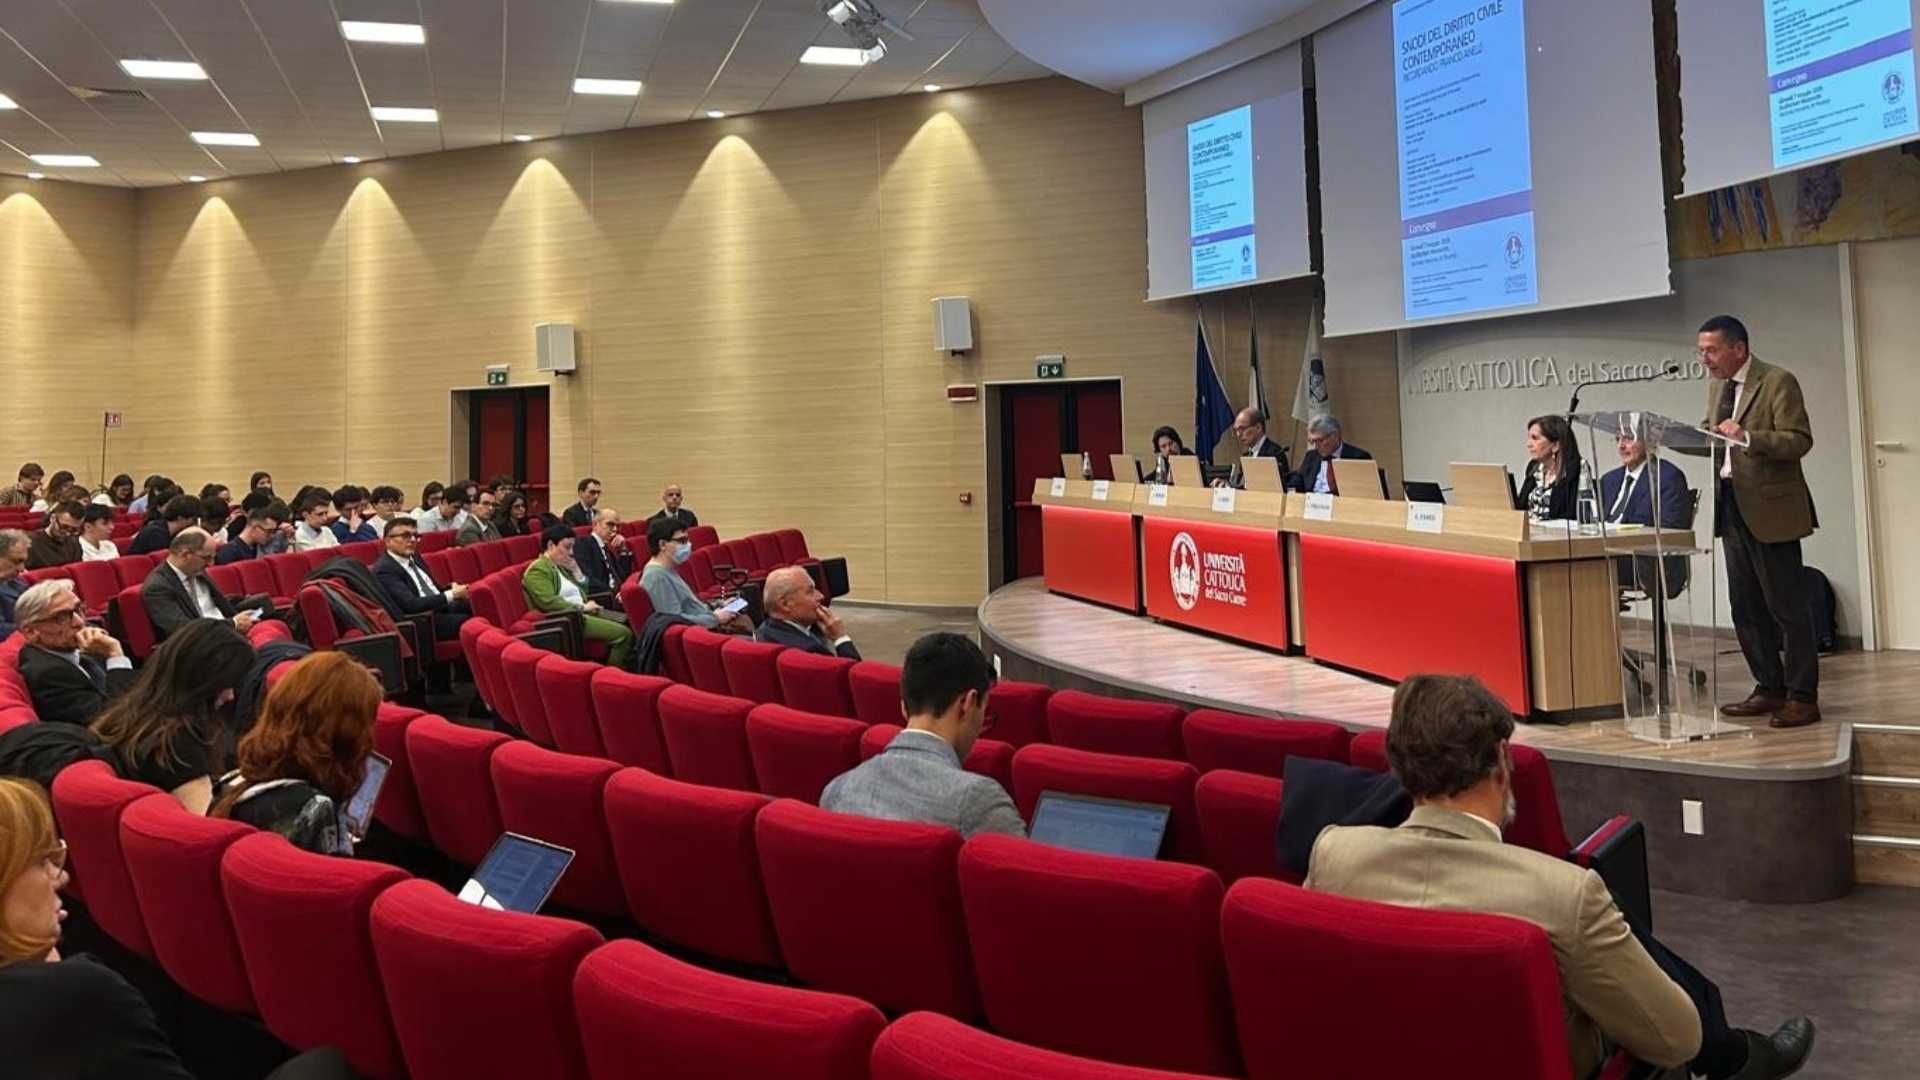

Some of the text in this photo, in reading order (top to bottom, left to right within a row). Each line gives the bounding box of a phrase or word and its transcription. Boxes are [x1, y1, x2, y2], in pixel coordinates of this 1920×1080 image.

[1427, 26, 1442, 43] DEL
[1477, 0, 1503, 21] CIVILE
[1402, 29, 1475, 71] CONTEMPORANEO
[1458, 356, 1561, 392] CATTOLICA
[1567, 360, 1594, 385] del
[1599, 360, 1652, 382] Sacro
[1203, 551, 1246, 575] UNIVERSITÀ
[1203, 568, 1247, 593] CATTOLICA
